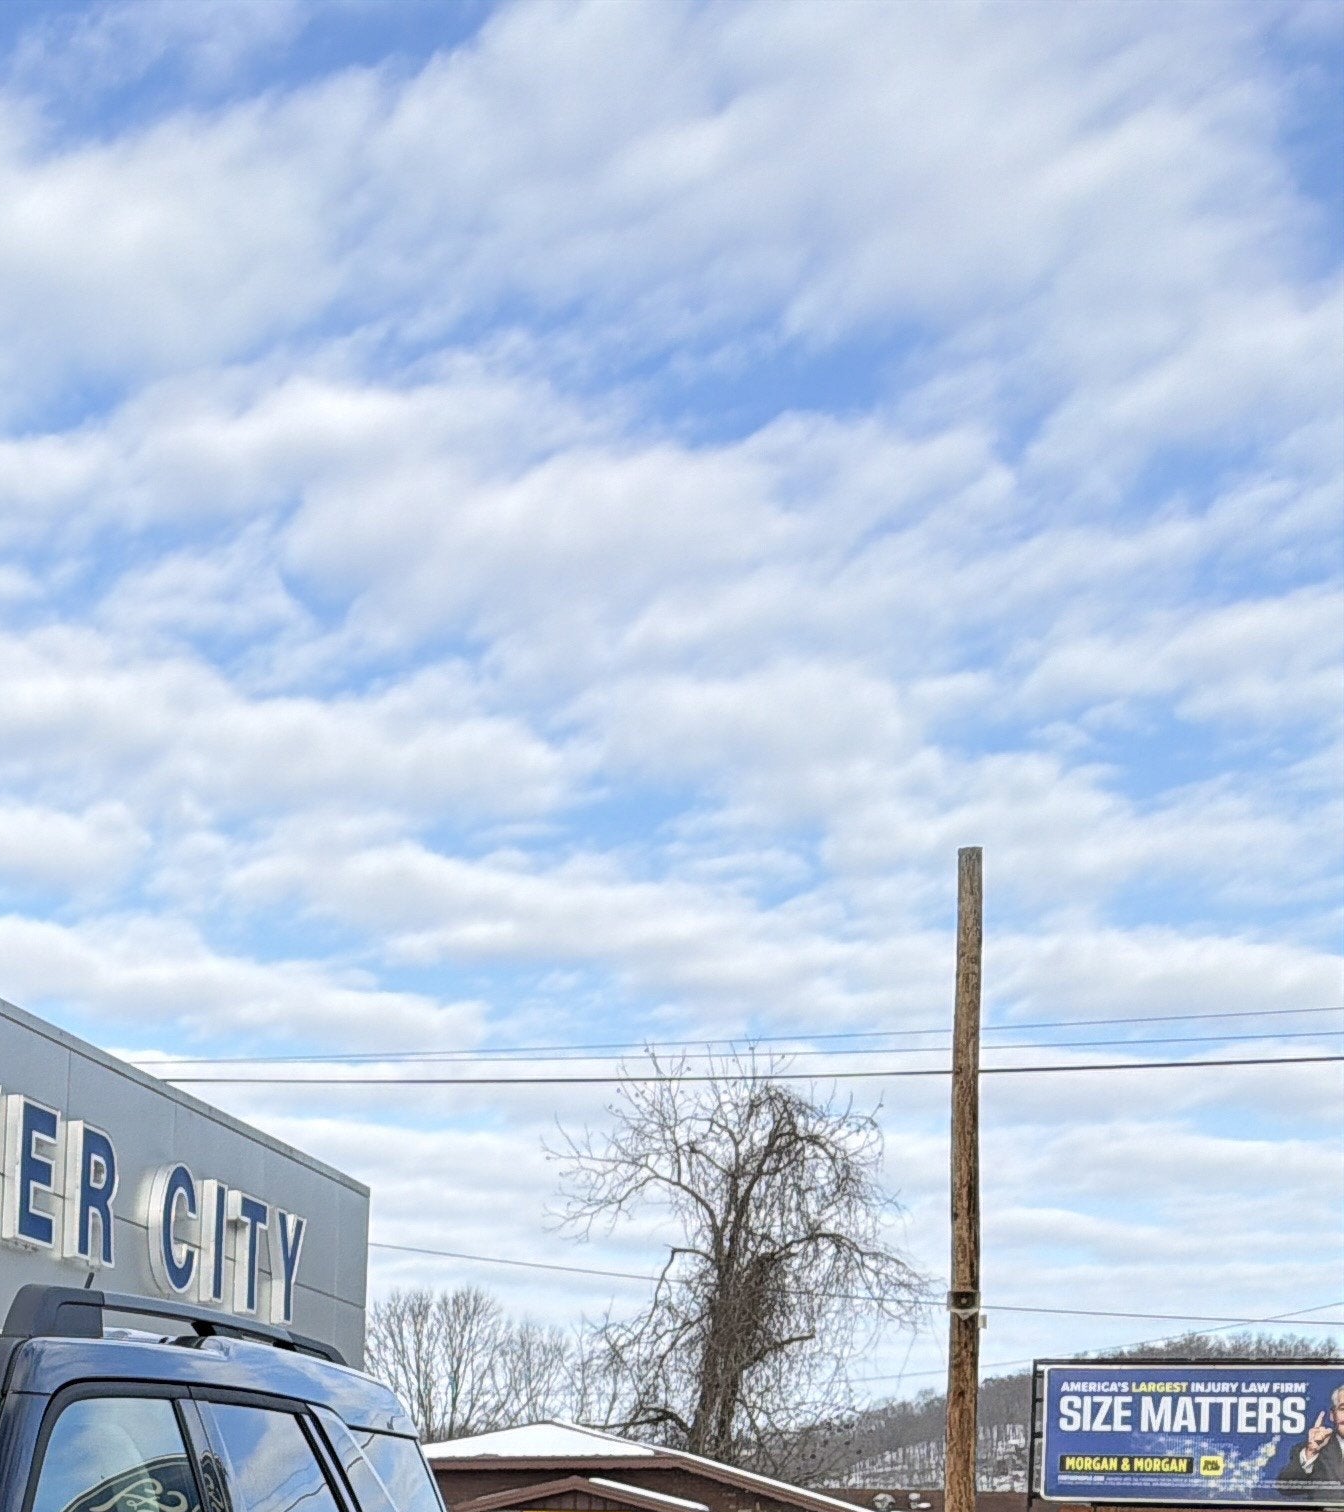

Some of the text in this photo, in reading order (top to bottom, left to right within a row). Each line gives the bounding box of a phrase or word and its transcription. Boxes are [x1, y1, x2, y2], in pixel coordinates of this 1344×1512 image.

[148, 1162, 307, 1325] CITY
[1060, 1381, 1307, 1394] AMERICA'S LARGEST INJURY LAW FIRM
[1059, 1395, 1307, 1434] SIZE MATTERS
[1065, 1456, 1118, 1471] MORGAN
[1120, 1457, 1130, 1471] &
[1133, 1457, 1187, 1473] MORGAN
